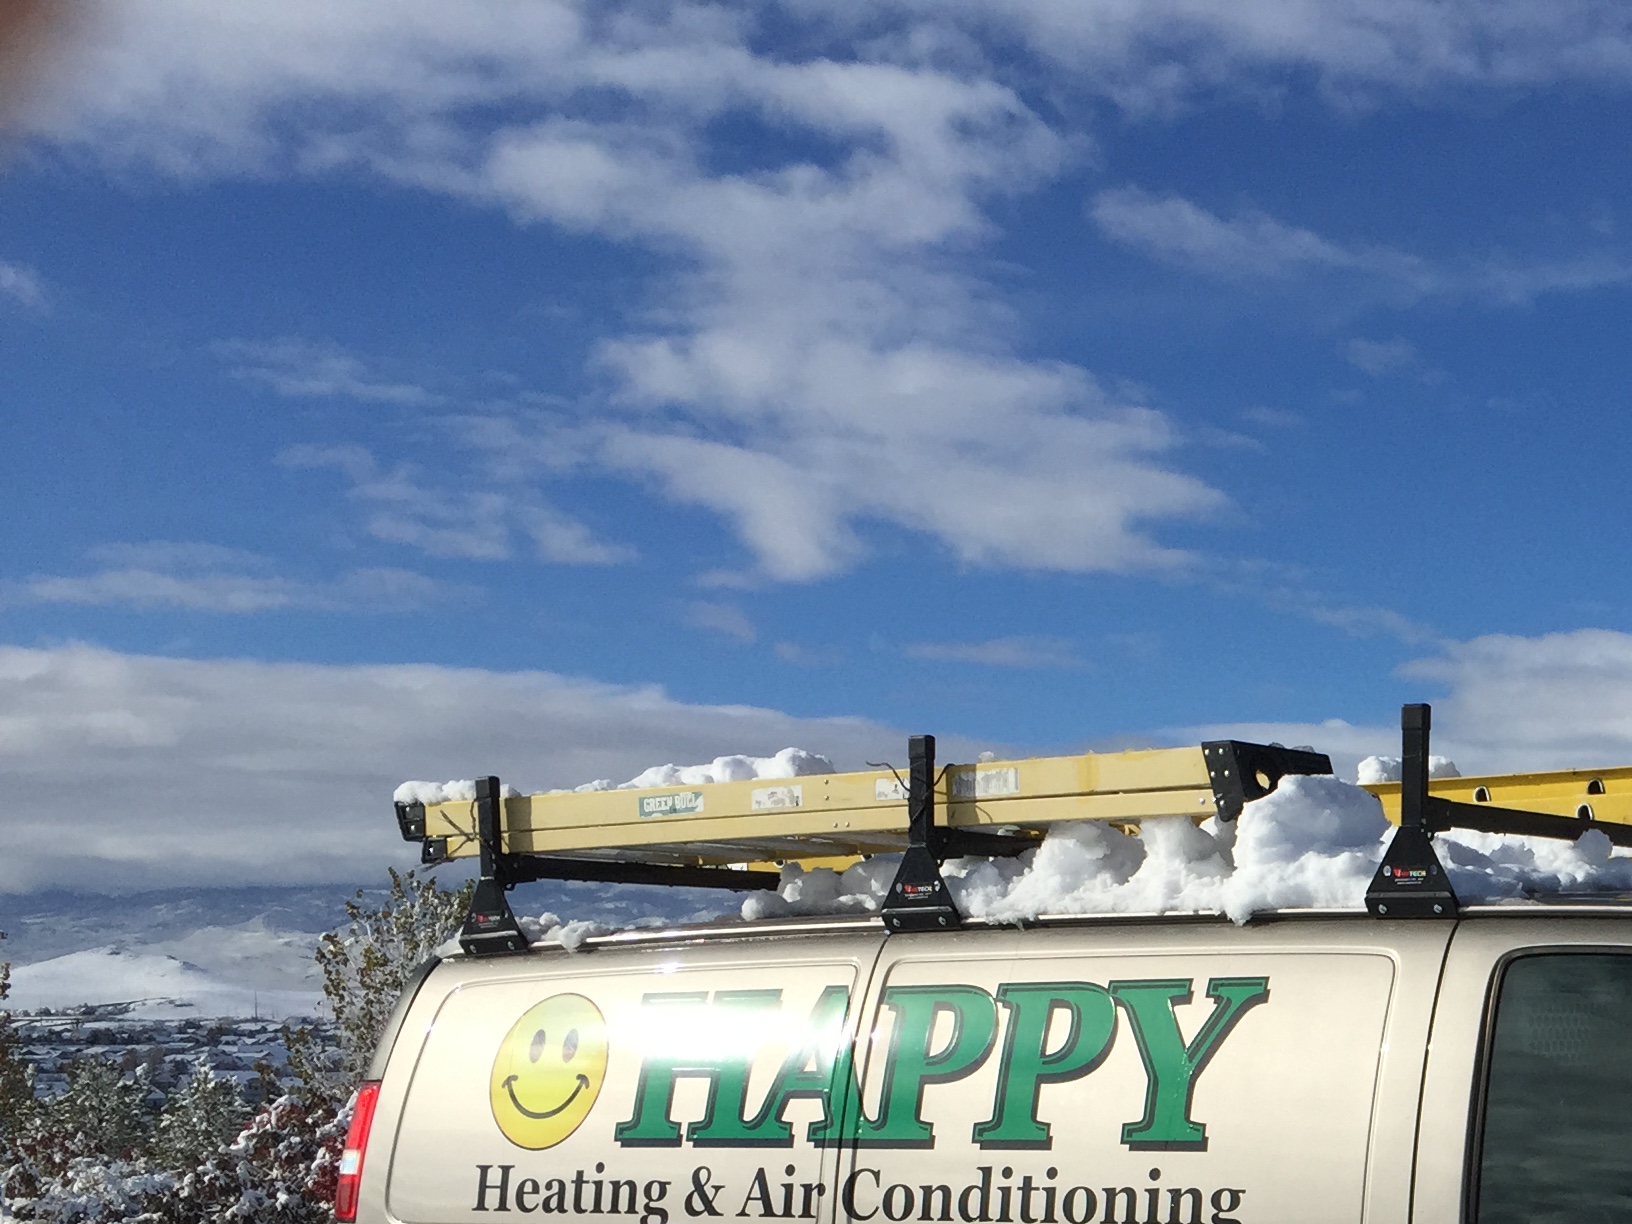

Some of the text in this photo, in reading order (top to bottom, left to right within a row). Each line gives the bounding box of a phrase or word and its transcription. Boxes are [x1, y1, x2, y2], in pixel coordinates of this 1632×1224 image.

[614, 976, 1270, 1152] HAPPY
[684, 1165, 726, 1217] &
[735, 1163, 827, 1219] Air
